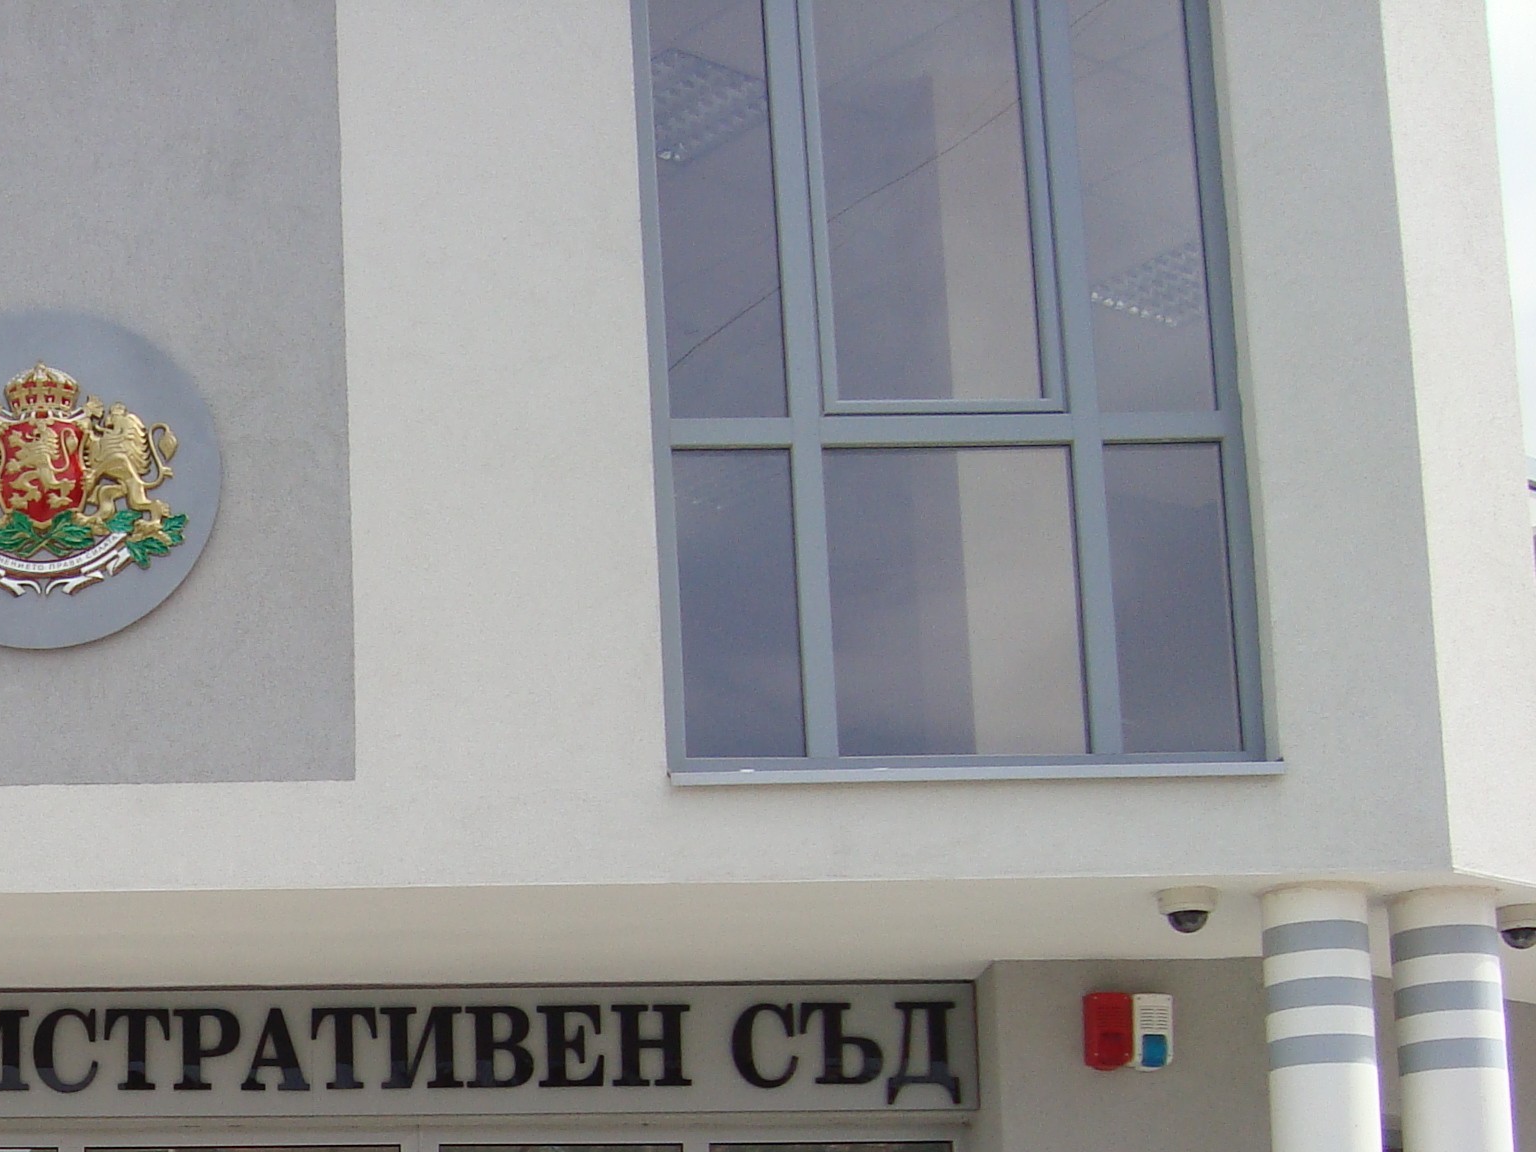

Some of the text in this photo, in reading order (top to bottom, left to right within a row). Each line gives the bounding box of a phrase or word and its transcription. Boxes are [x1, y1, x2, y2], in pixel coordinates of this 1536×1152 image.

[48, 558, 83, 571] ПРАВИ
[84, 535, 120, 562] СИЛАТА
[731, 1002, 962, 1106] СЪД
